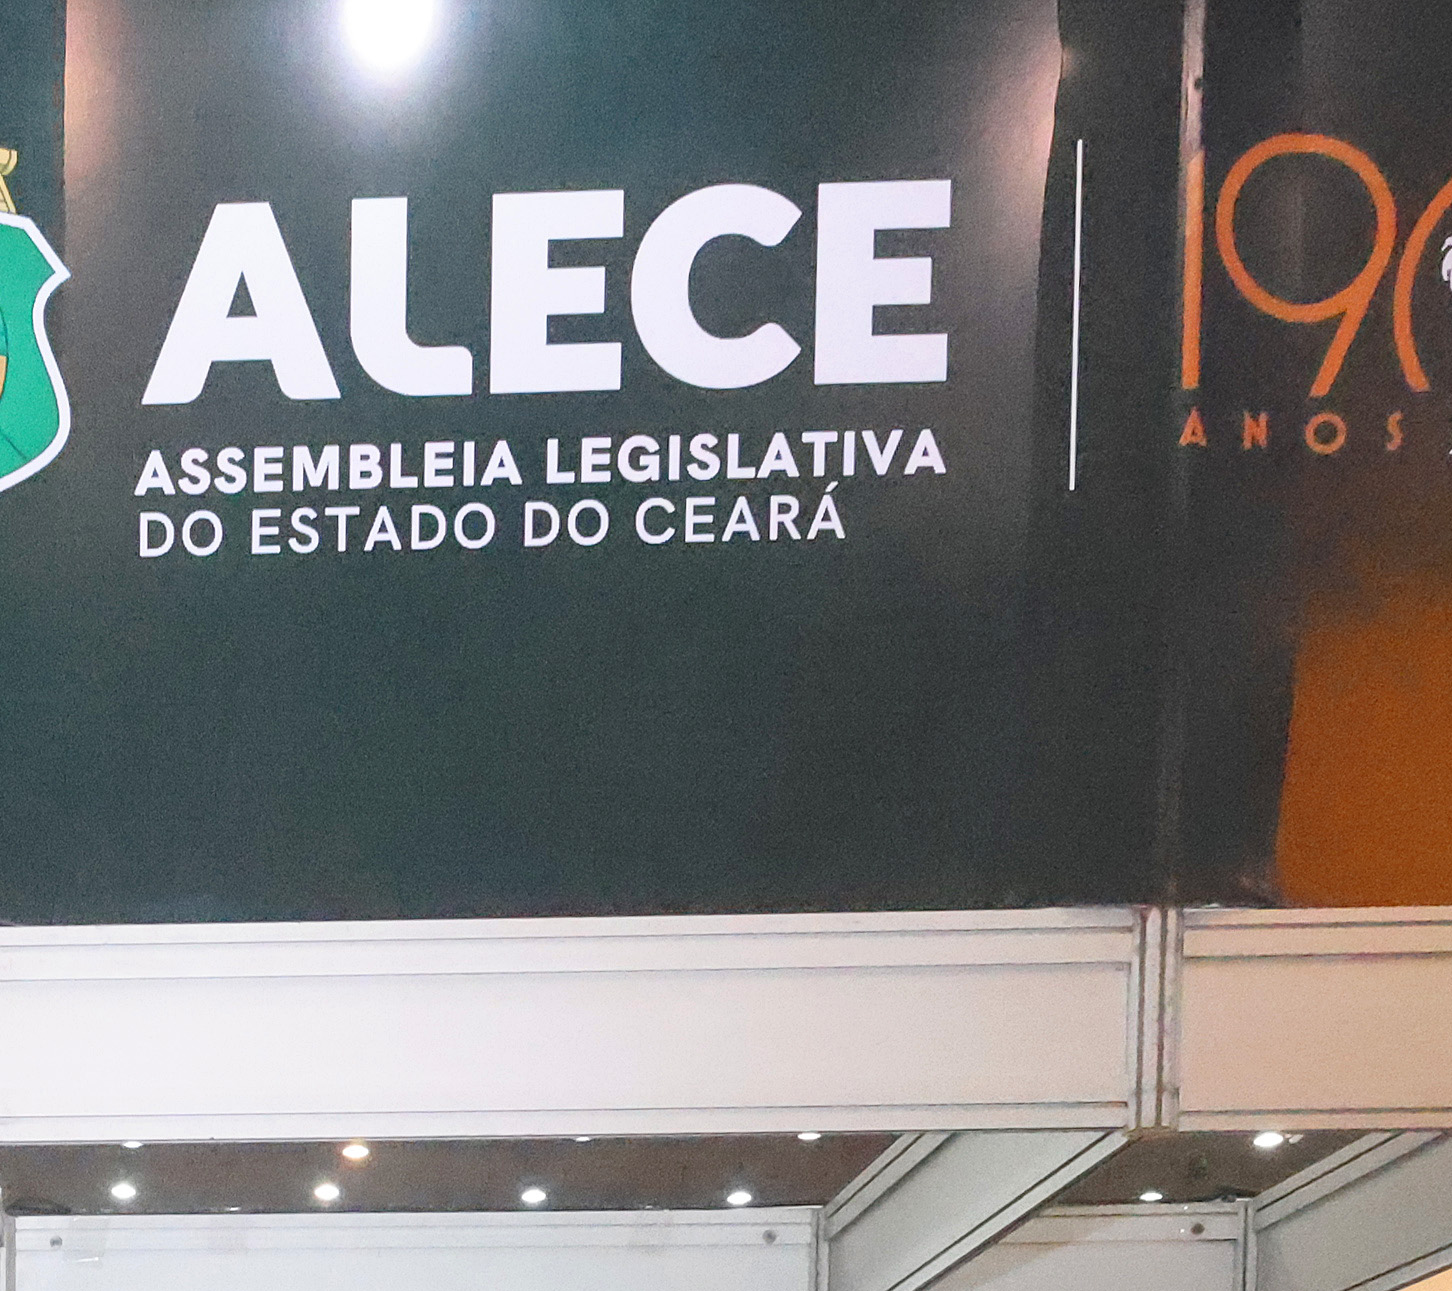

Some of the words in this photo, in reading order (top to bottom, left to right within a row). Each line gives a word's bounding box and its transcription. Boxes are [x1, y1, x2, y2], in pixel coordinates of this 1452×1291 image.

[141, 179, 952, 405] ALECE
[134, 440, 522, 496] ASSEMBLEIA
[547, 429, 947, 485] LEGISLATIVA
[1179, 409, 1404, 455] ANOS
[139, 510, 224, 558] DO
[251, 501, 495, 554] ESTADO
[524, 499, 609, 549] DO
[635, 483, 846, 544] CEARÁ
